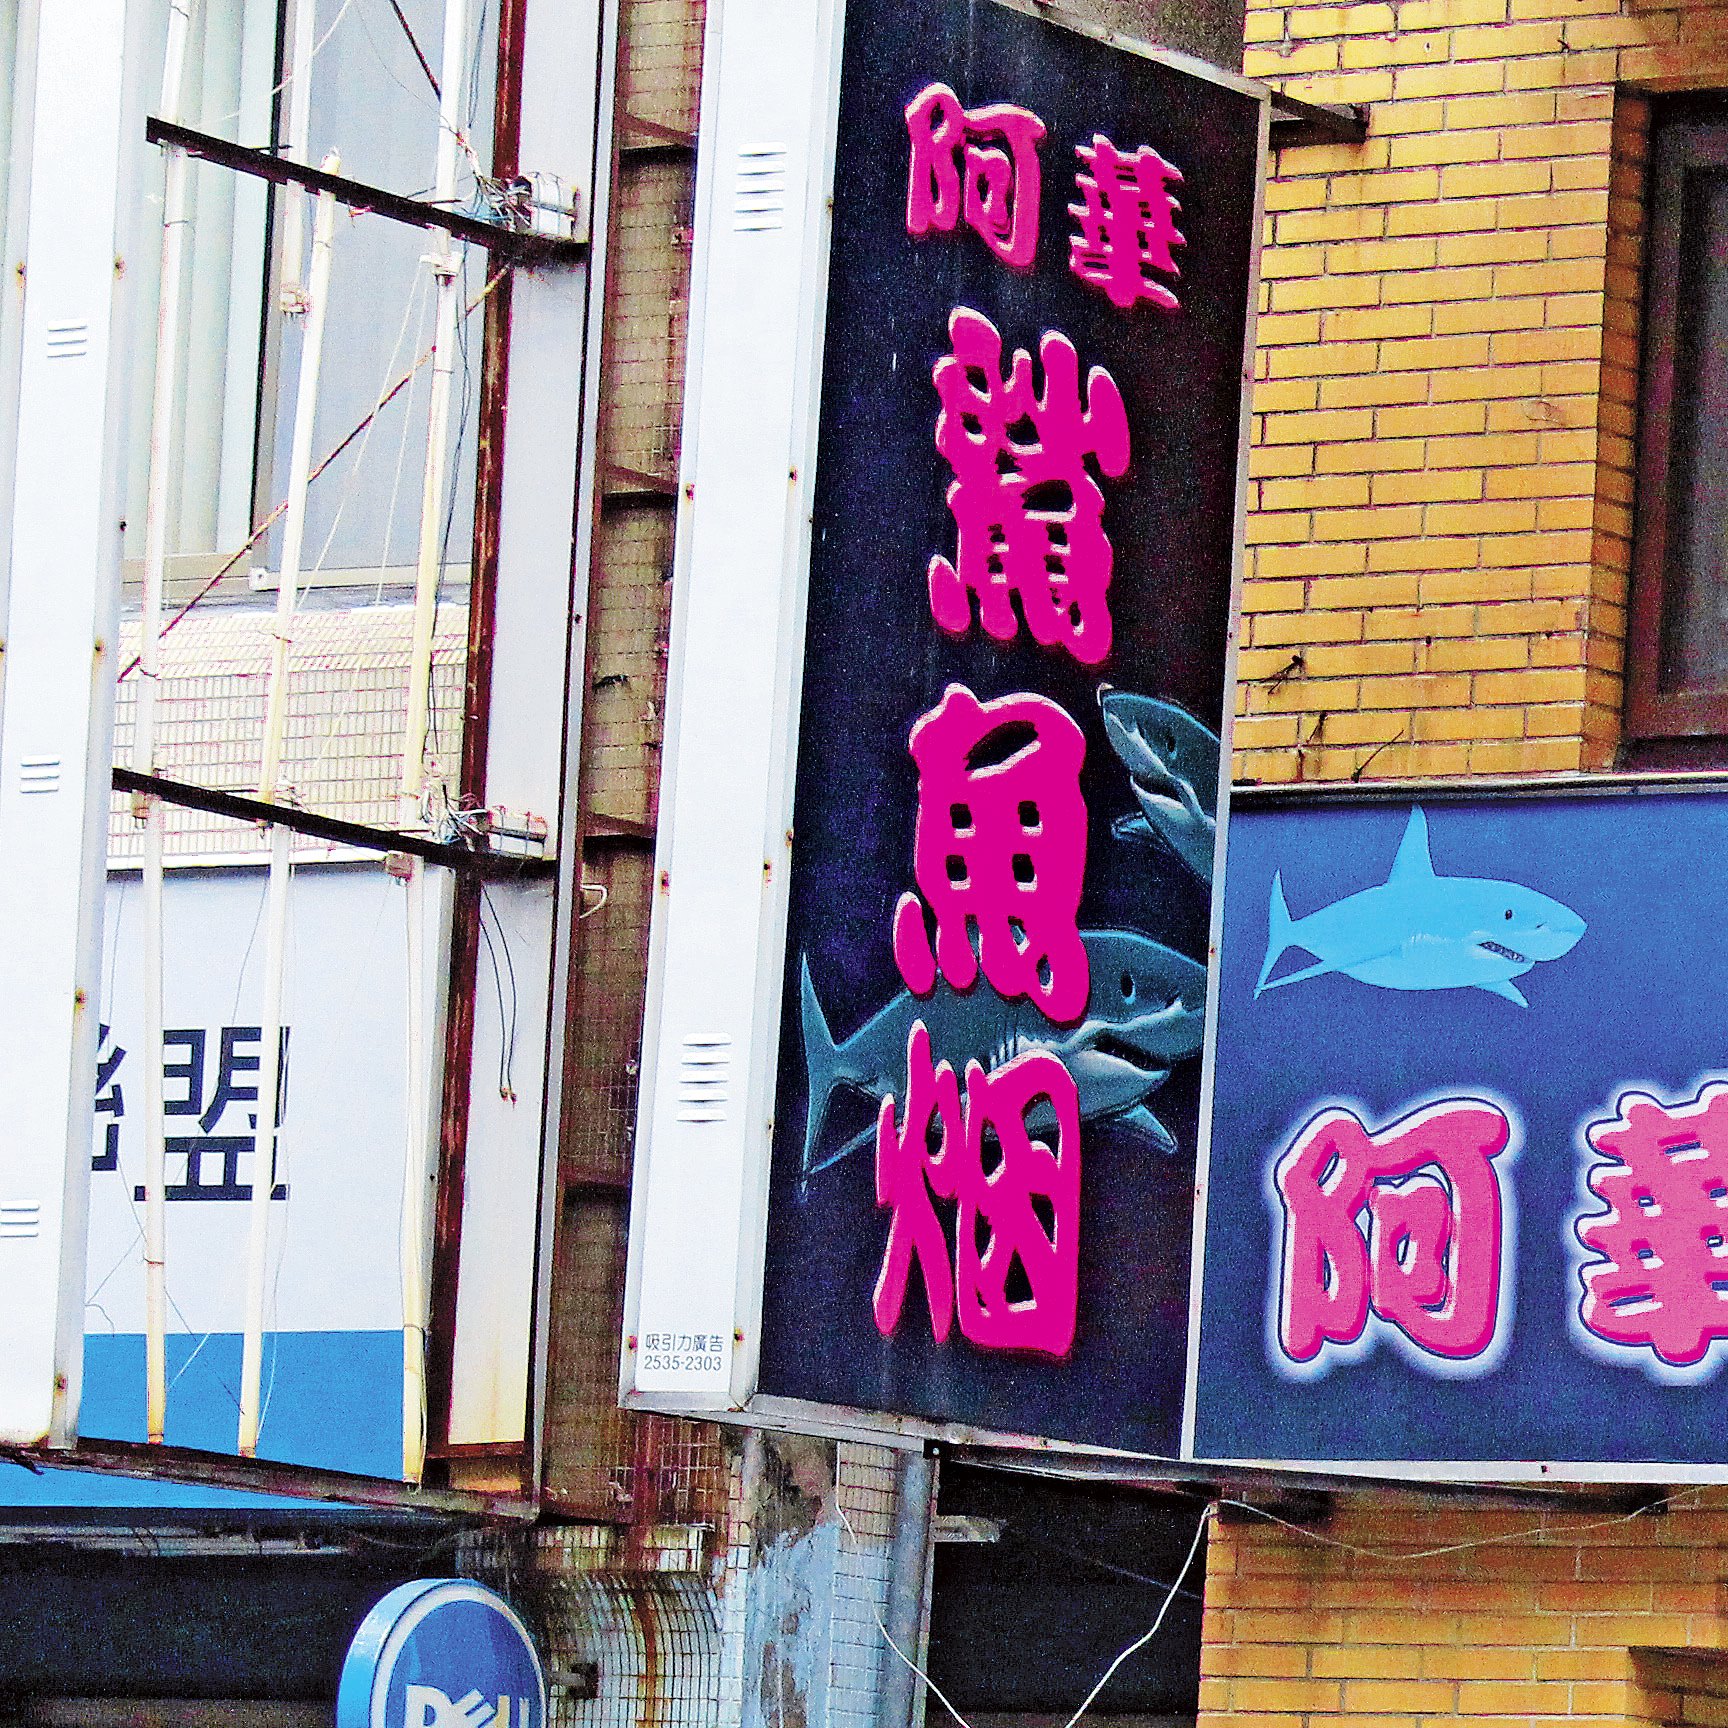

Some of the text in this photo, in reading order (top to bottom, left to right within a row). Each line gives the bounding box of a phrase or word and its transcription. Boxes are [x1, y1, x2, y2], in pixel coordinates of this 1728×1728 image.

[645, 1333, 724, 1353] 吸引力廣告
[644, 1355, 722, 1371] 2535-2303
